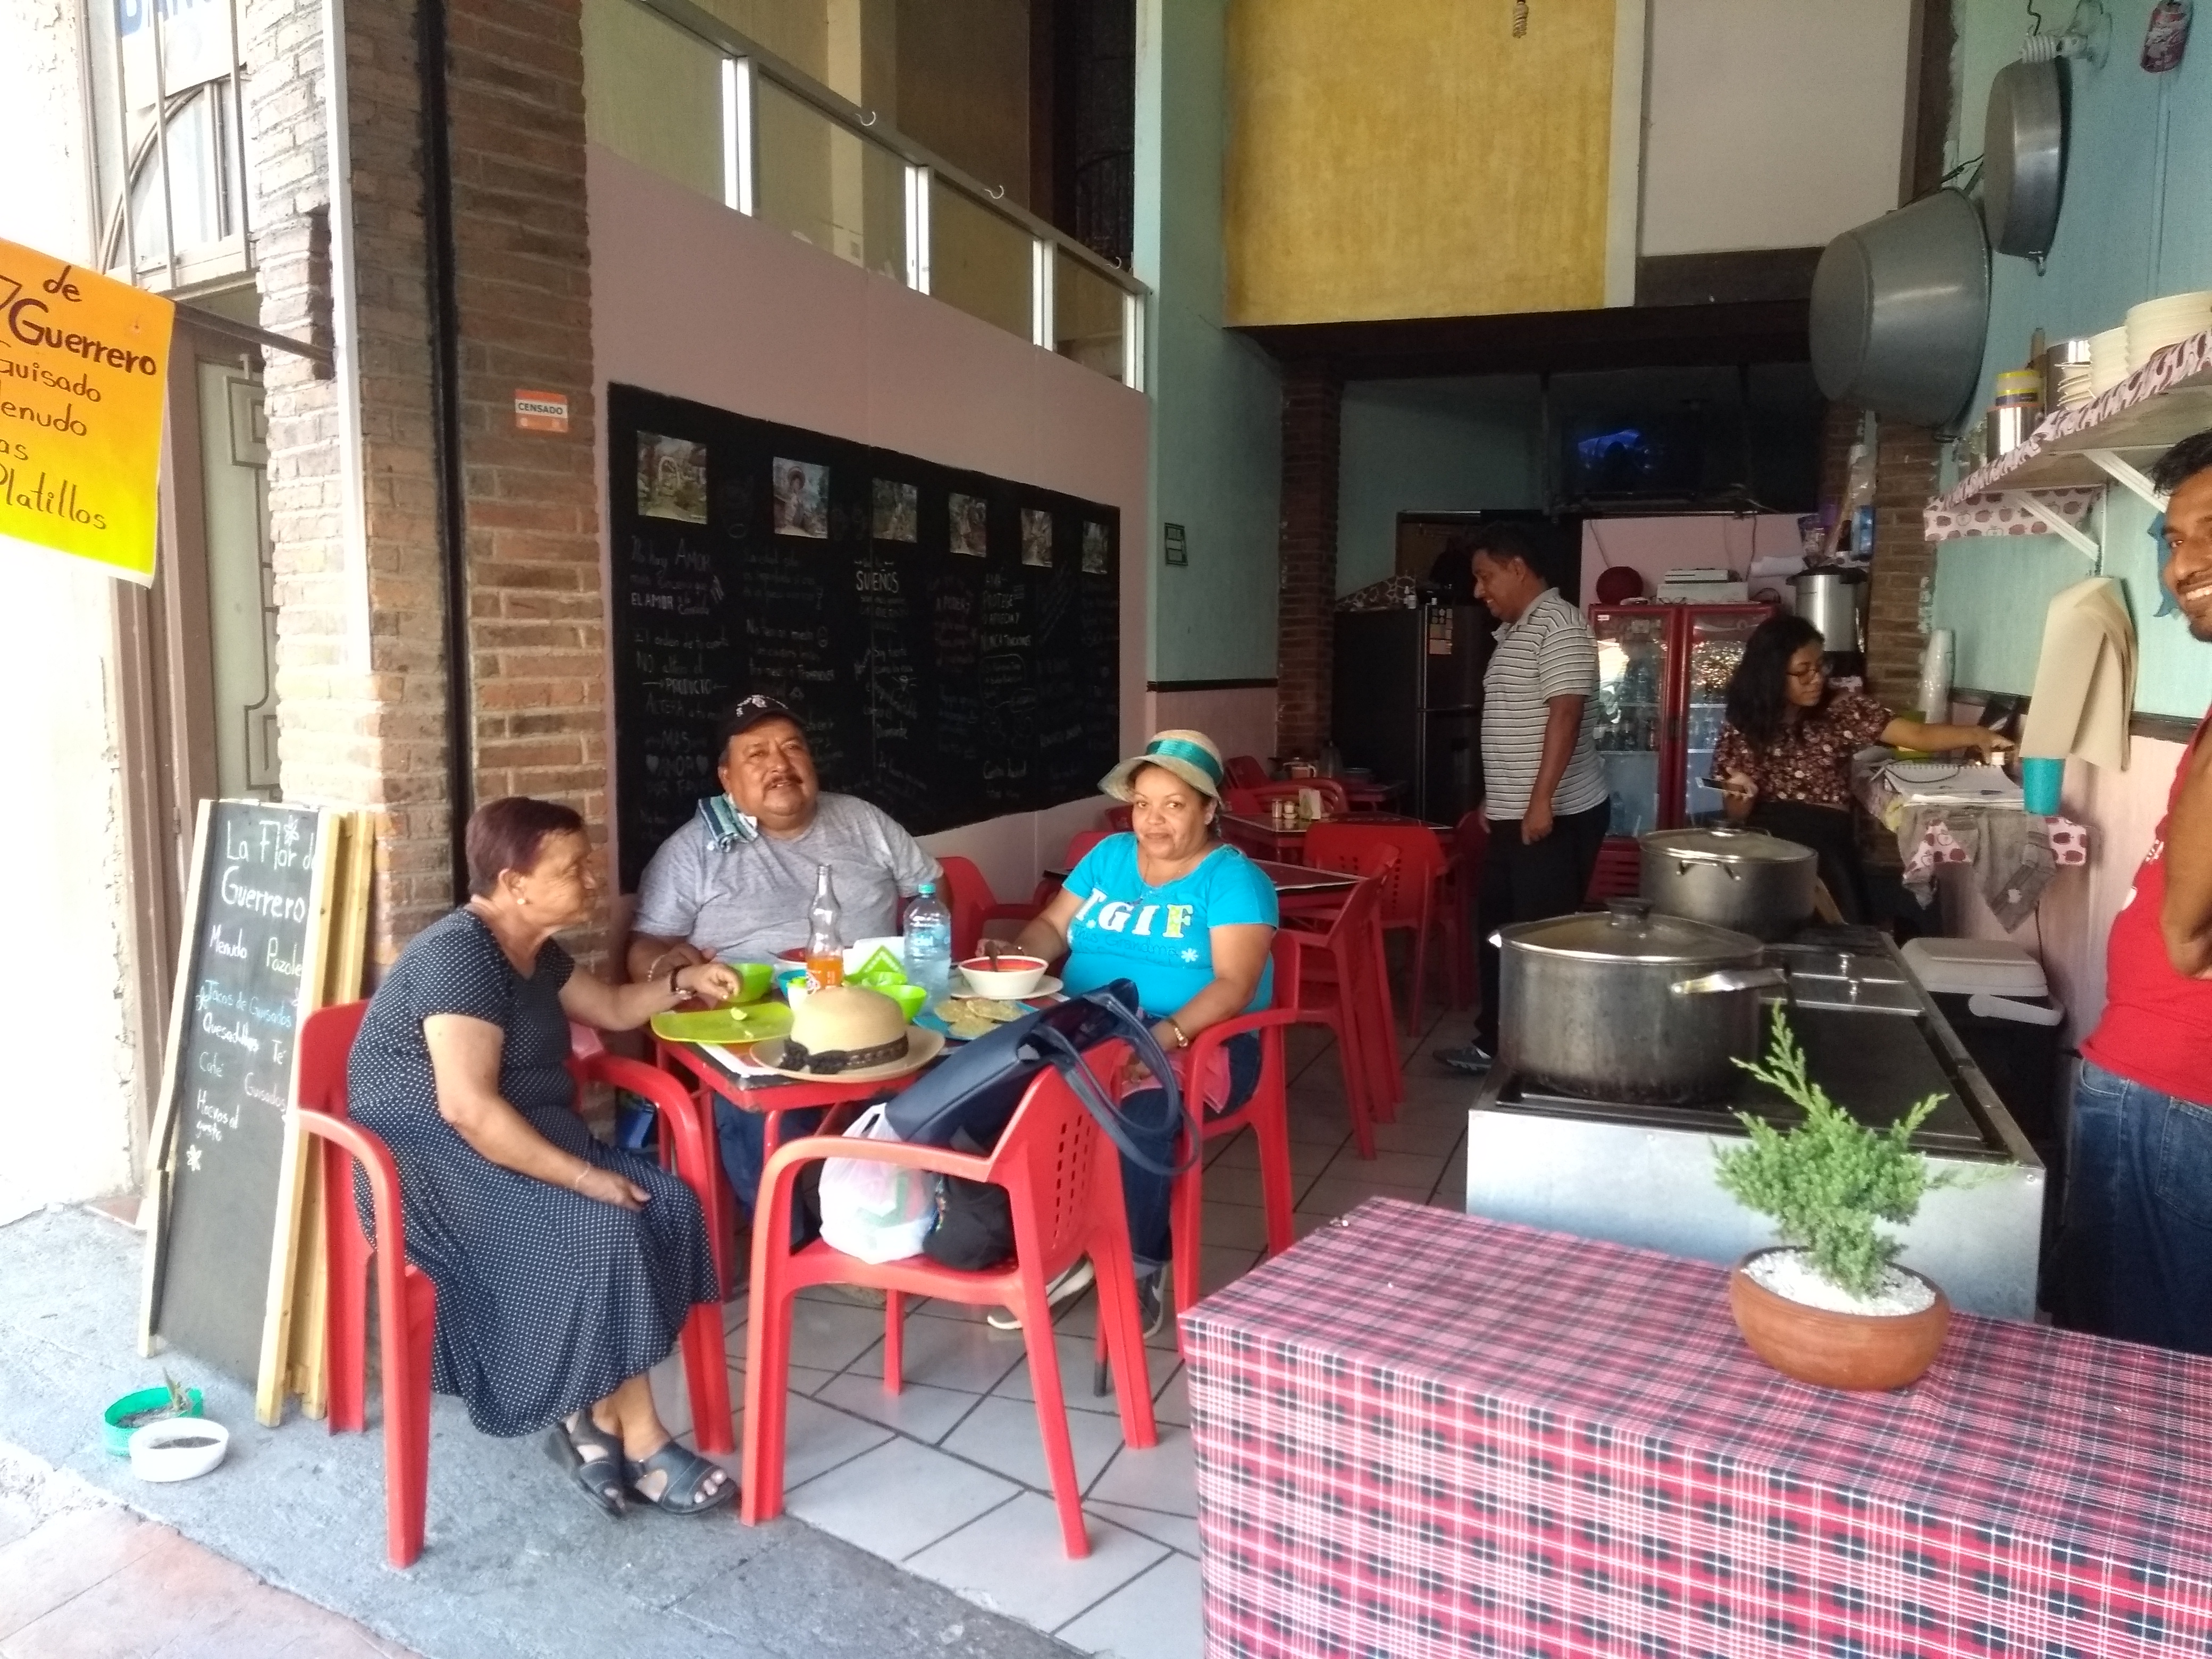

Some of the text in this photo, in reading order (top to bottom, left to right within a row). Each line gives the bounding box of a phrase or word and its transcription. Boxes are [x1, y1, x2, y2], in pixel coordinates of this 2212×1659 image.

[43, 264, 82, 303] de
[8, 298, 157, 376] Guerrero
[0, 402, 88, 437] enudo
[518, 403, 563, 415] CENSADO
[855, 568, 900, 594] SUEÑOS
[227, 820, 314, 870] La Flor d
[222, 865, 305, 923] Guerrero
[210, 924, 248, 959] Menudo
[1104, 933, 1179, 958] Grandma
[236, 991, 247, 1011] de
[197, 1088, 229, 1125] Huevos
[244, 1071, 287, 1112] Guisados
